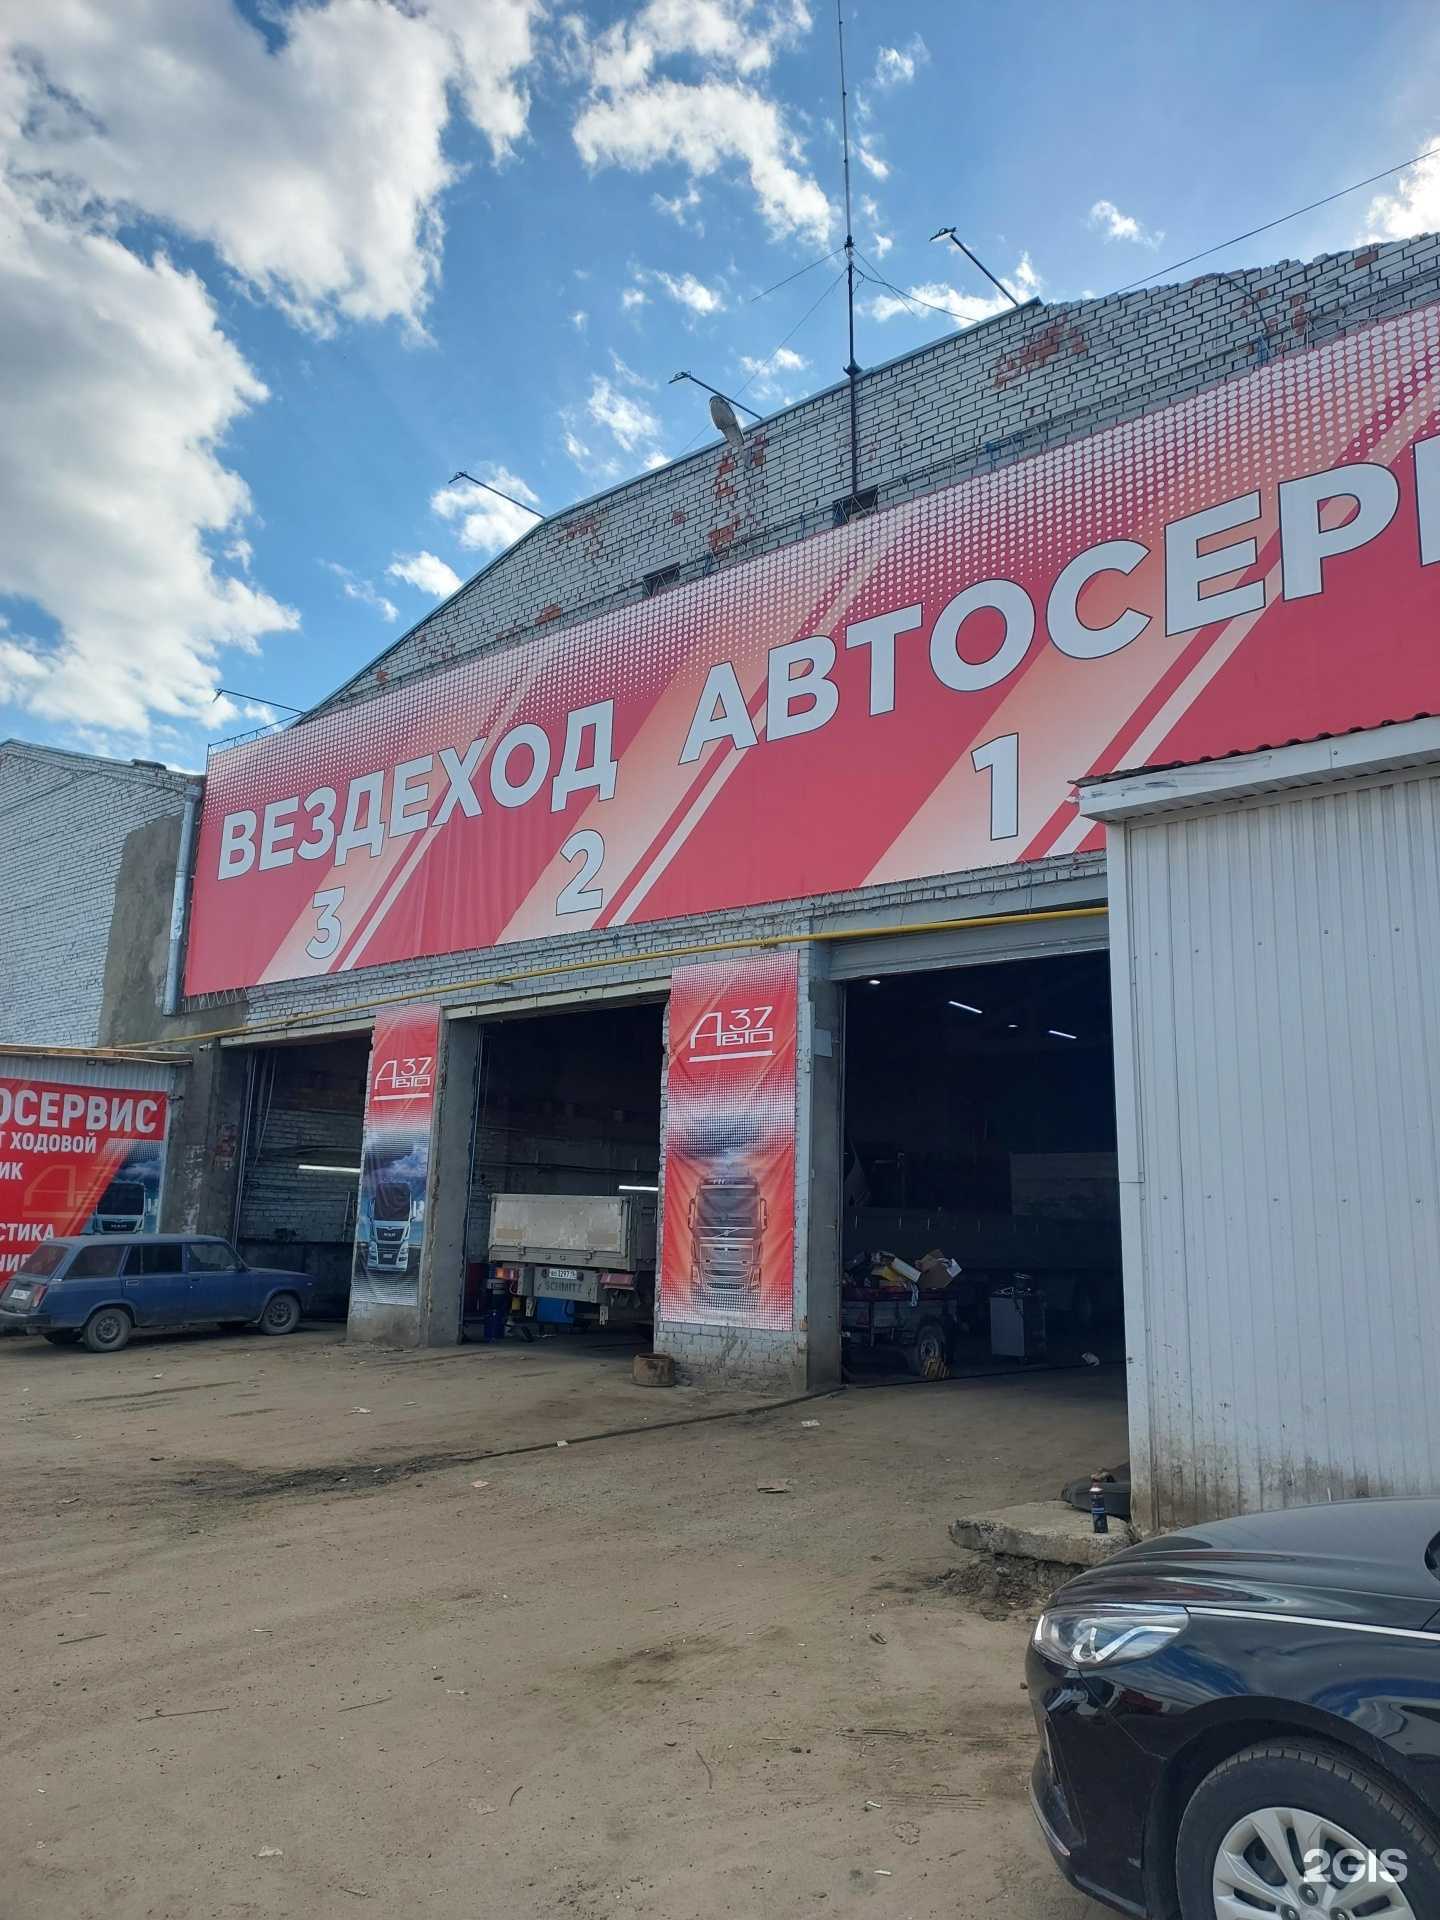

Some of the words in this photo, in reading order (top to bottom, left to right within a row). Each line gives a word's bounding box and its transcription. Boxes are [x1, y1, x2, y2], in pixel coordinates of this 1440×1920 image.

[217, 699, 619, 880] ВЕЗДЕХОД
[971, 733, 1020, 841] 1
[555, 829, 605, 916] 2
[305, 886, 346, 960] 3
[10, 1131, 97, 1154] ХОДОВОЙ
